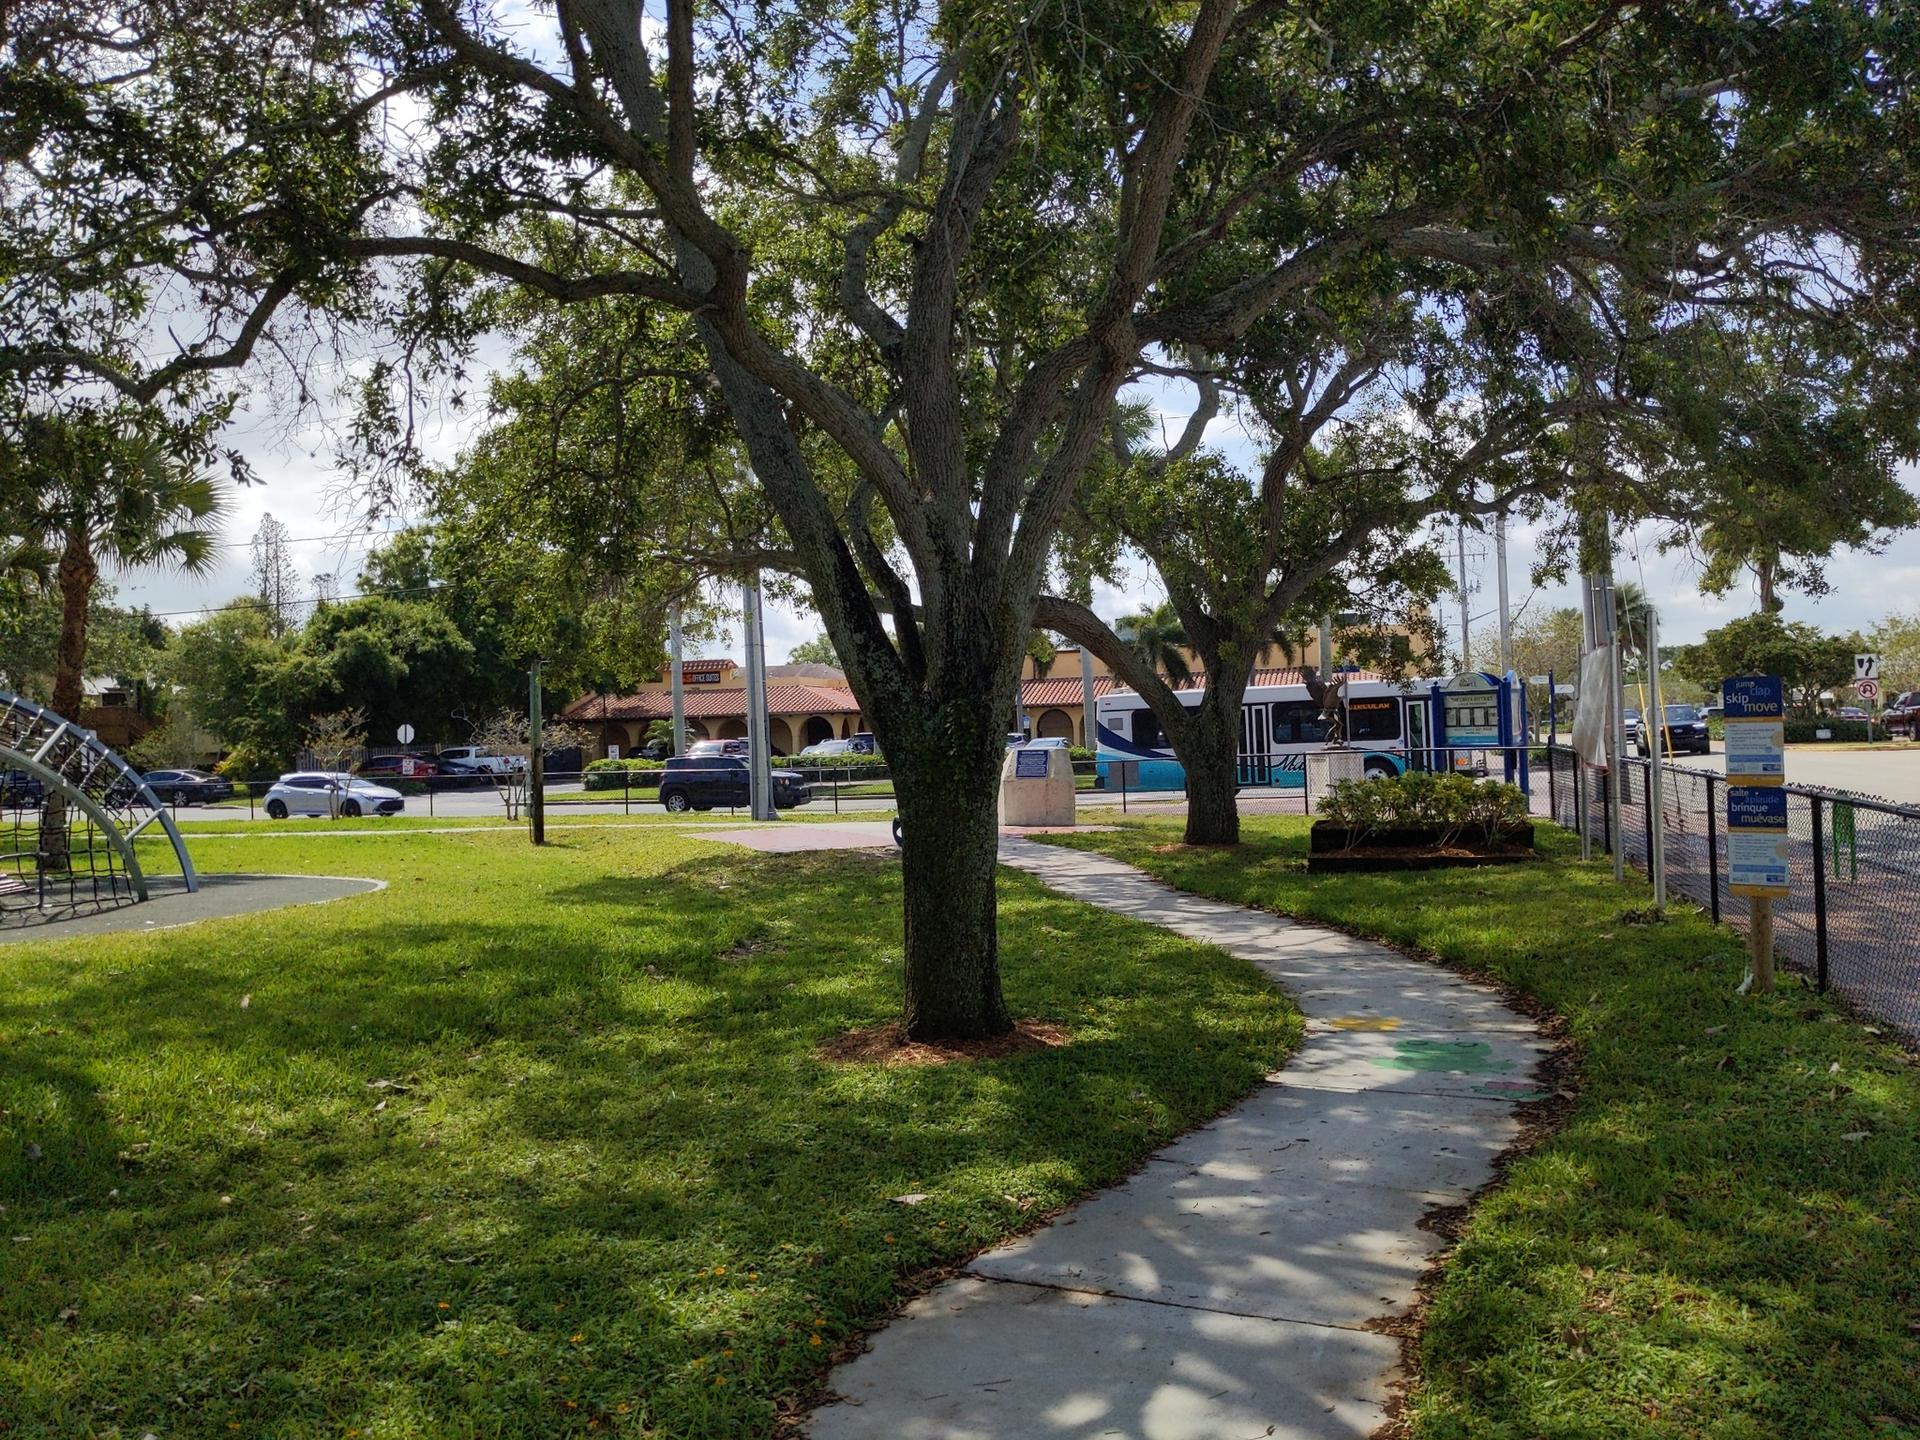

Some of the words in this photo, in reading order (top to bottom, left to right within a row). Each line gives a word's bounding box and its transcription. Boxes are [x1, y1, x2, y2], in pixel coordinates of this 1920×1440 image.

[1735, 680, 1755, 689] jump
[1750, 685, 1771, 697] clap
[1725, 693, 1749, 706] skip
[1744, 702, 1778, 712] move
[1730, 788, 1749, 797] salte
[1731, 802, 1769, 814] brinque
[1741, 813, 1785, 824] muévase
